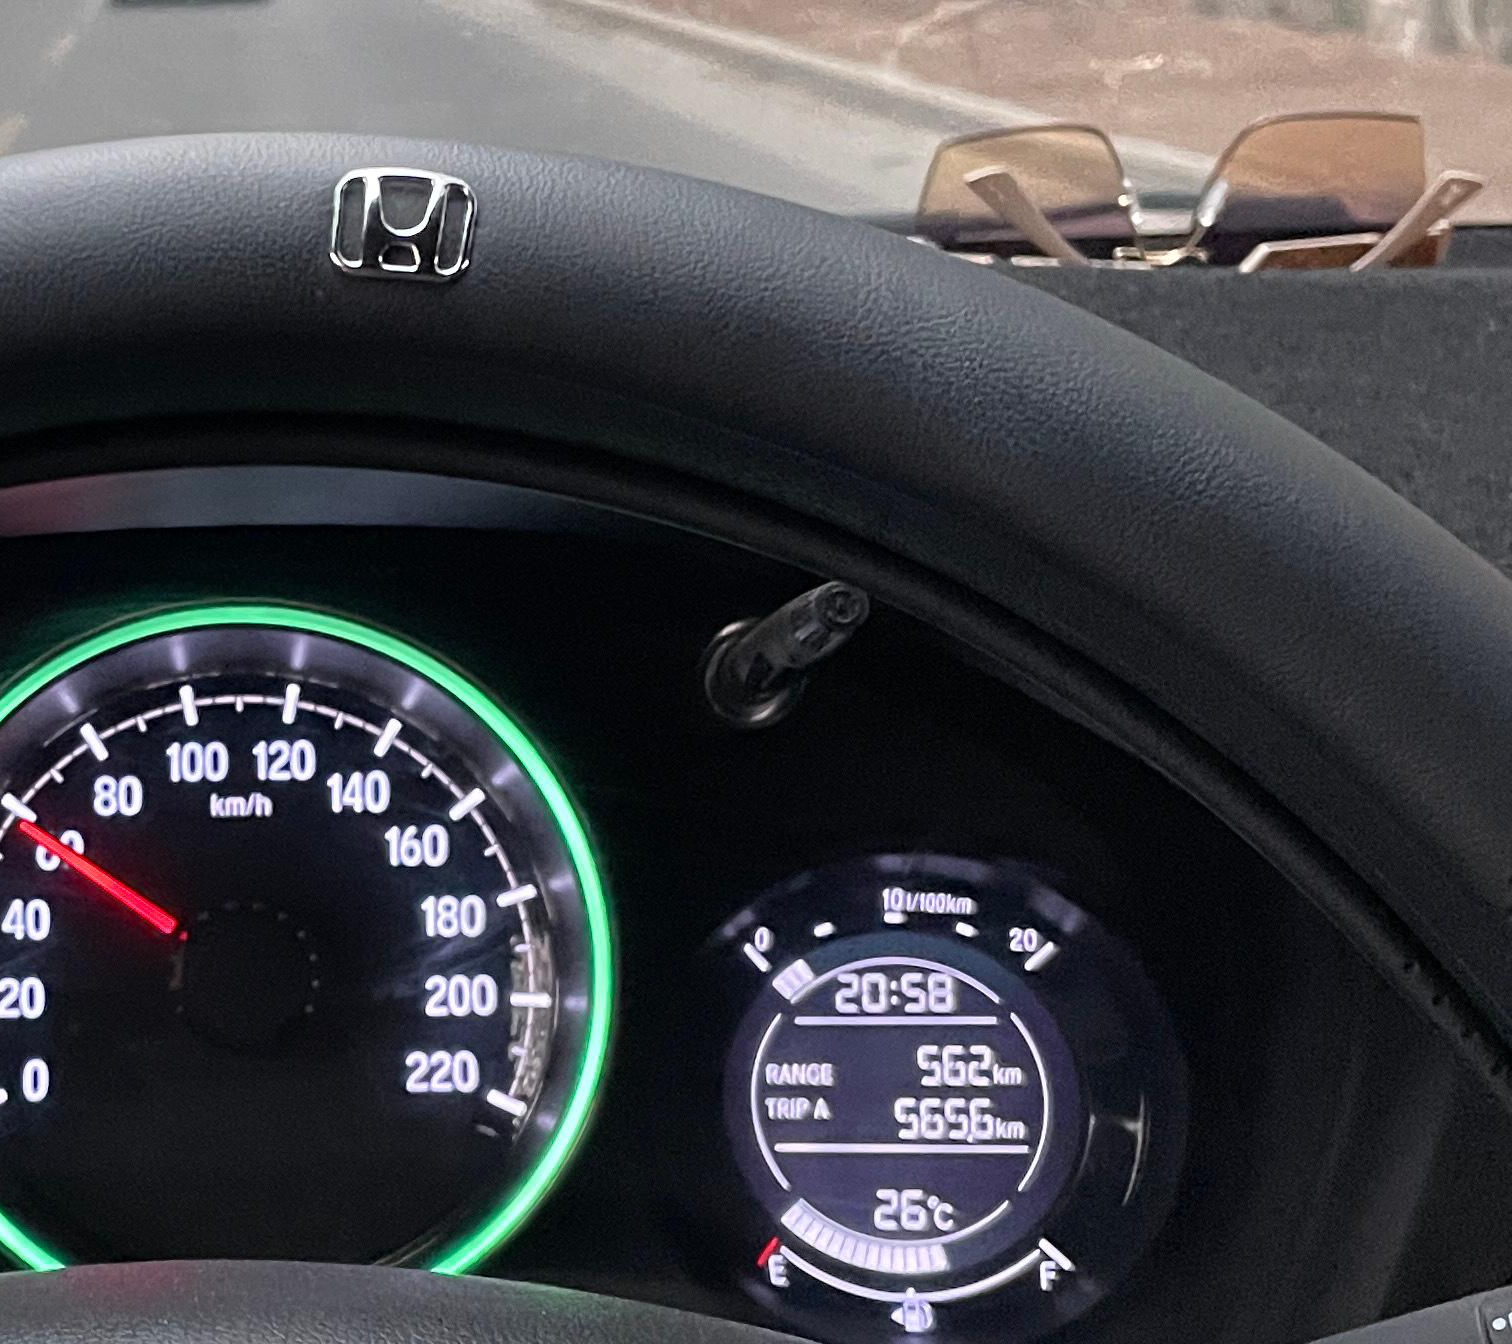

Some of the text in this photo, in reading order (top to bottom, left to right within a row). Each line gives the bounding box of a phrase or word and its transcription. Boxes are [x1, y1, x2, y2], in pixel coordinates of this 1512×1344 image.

[165, 741, 229, 783] 100
[251, 738, 317, 782] 120
[93, 774, 143, 817] 80
[209, 792, 273, 818] km/h
[326, 769, 391, 814] 140
[383, 823, 449, 868] 160
[0, 898, 51, 942] 40
[420, 894, 487, 939] 180
[754, 926, 774, 952] 0
[1008, 926, 1039, 953] 20
[424, 973, 498, 1018] 200
[834, 971, 957, 1014] 20:58
[22, 1058, 50, 1103] 0
[404, 1049, 480, 1094] 220
[764, 1062, 835, 1087] RANGE
[764, 1097, 812, 1121] TRIP
[813, 1097, 832, 1121] A
[767, 1256, 790, 1288] E
[1039, 1261, 1059, 1291] F
